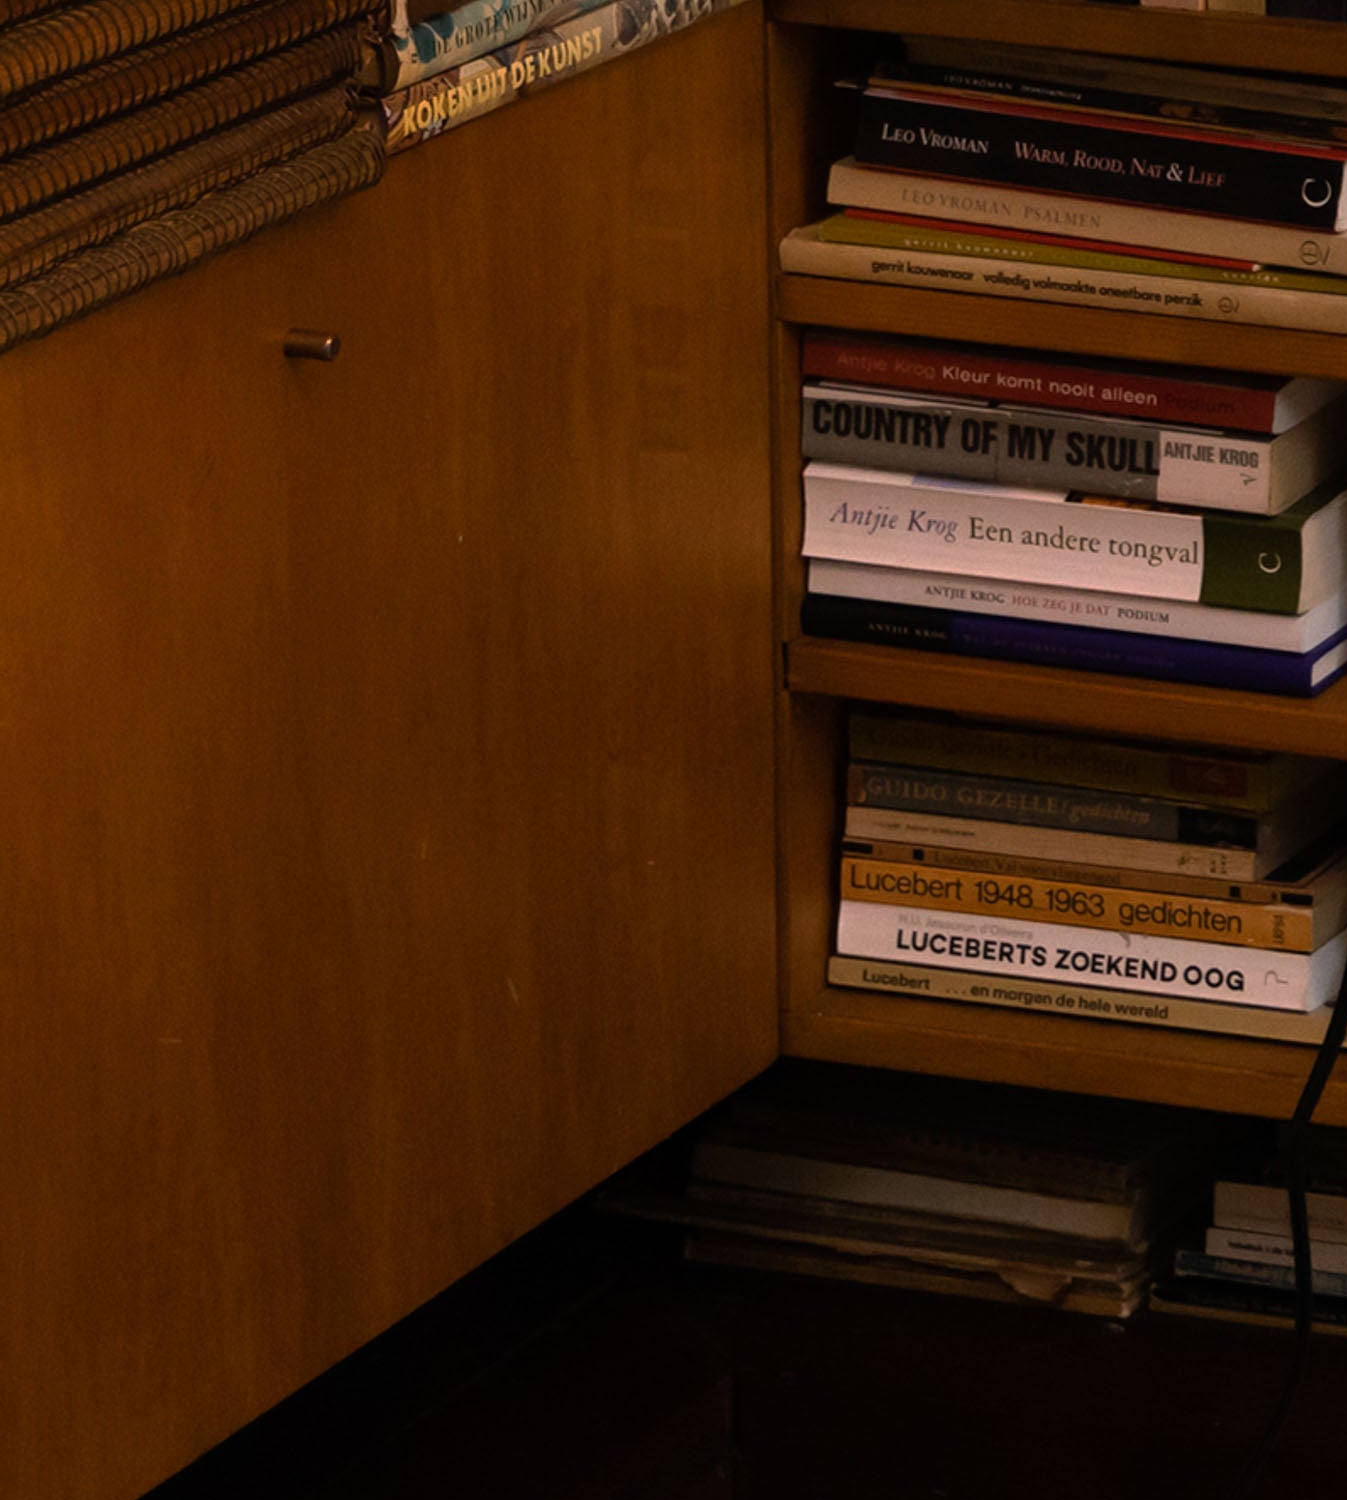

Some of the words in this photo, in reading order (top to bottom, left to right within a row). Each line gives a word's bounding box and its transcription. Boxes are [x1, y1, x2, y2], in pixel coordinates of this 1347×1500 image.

[401, 81, 475, 138] KOKEN
[476, 70, 508, 107] UIT
[511, 61, 536, 90] DE
[539, 27, 603, 78] KUNST
[811, 402, 950, 453] COUNTRY
[960, 420, 996, 454] OF
[1007, 425, 1054, 462] MY
[1066, 432, 1158, 476] SKULL
[829, 502, 902, 535] Antjie
[906, 512, 958, 543] Krog
[968, 517, 1014, 544] Een
[1021, 523, 1099, 551] andere
[1109, 532, 1199, 566] tongval
[850, 863, 962, 901] Lucebert
[1119, 902, 1243, 935] gedichten
[897, 929, 1046, 967] LUCEBERTS
[1055, 949, 1177, 982] ZOEKEND
[1183, 967, 1245, 991] OOG
